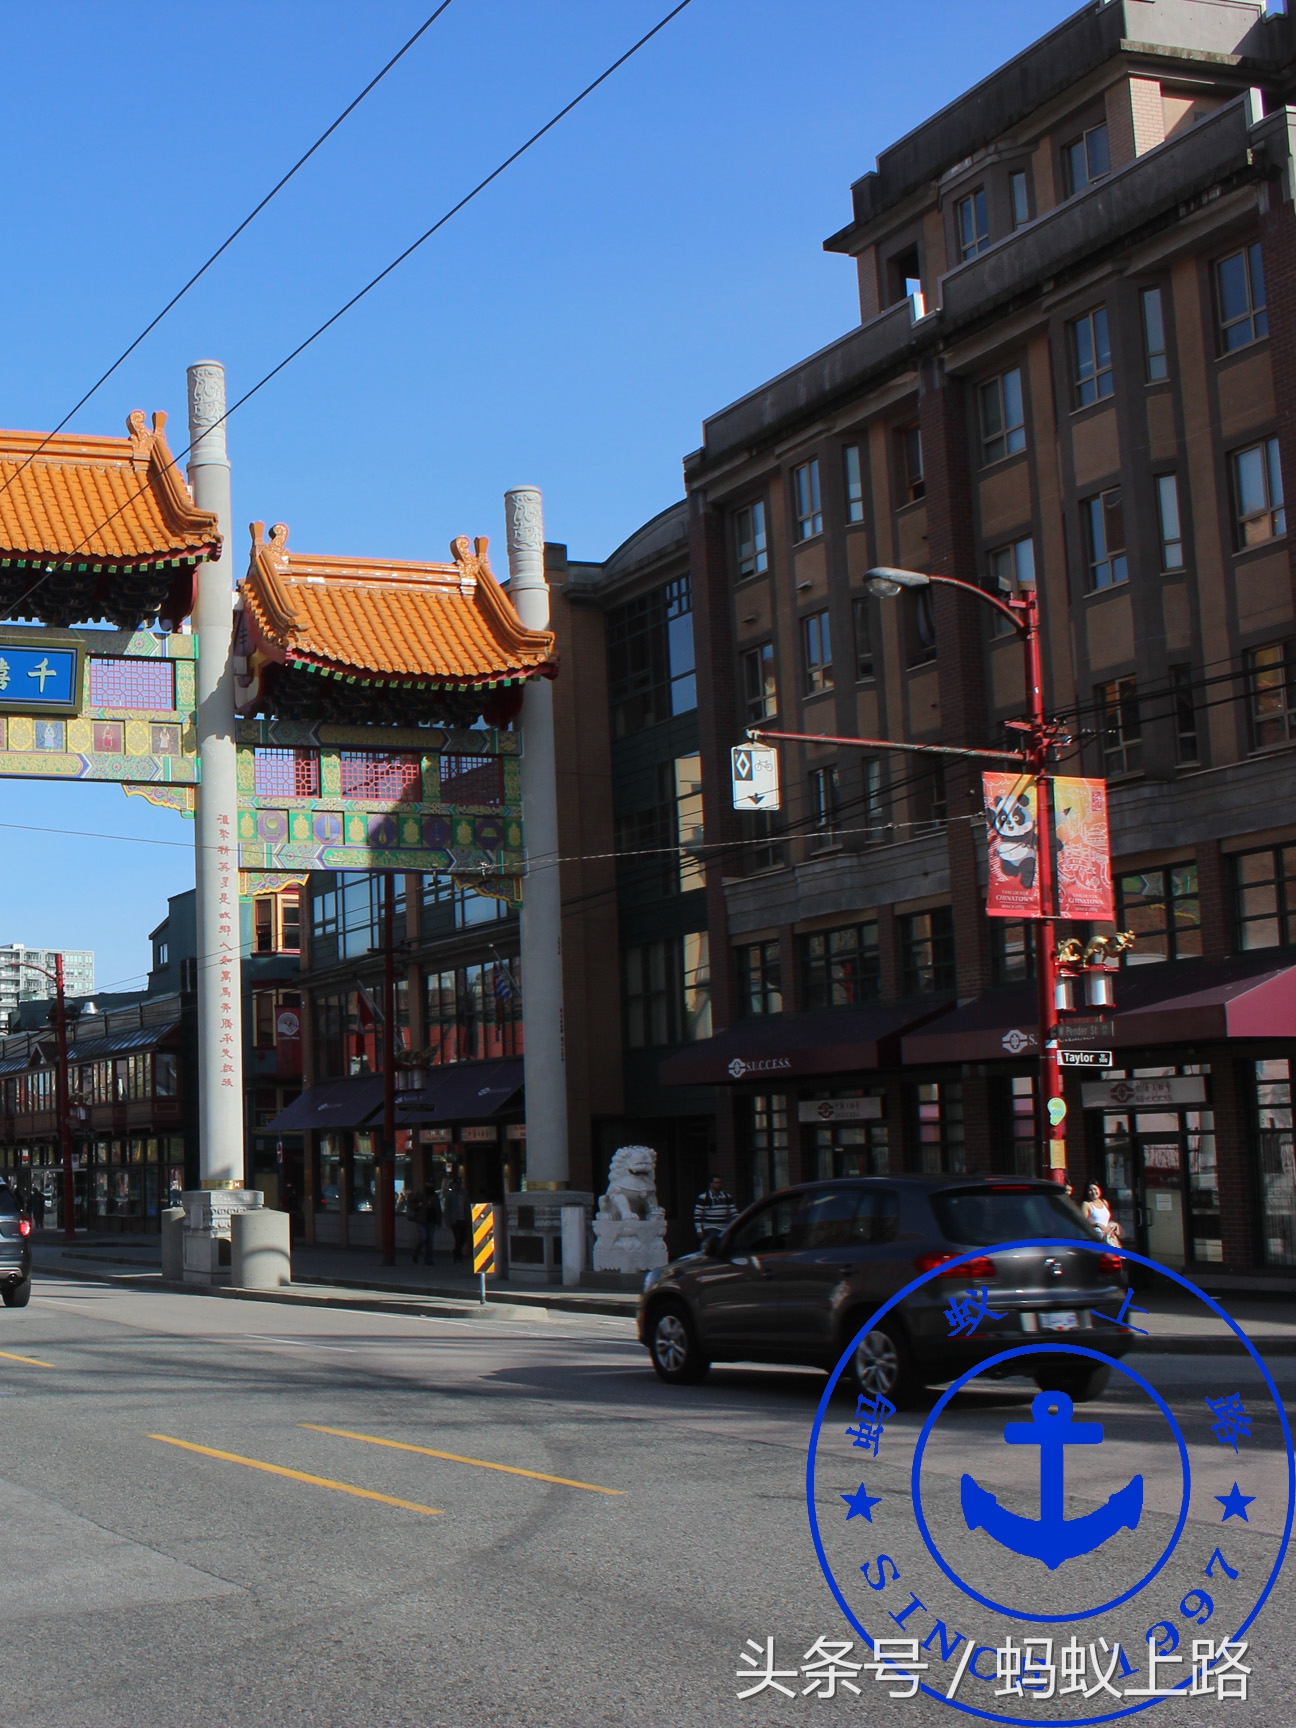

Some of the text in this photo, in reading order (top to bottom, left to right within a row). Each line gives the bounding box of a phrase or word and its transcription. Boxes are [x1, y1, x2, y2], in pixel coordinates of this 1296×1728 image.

[995, 894, 1034, 903] CHINATOWN
[1067, 897, 1104, 905] CHINATOWN
[1065, 1025, 1088, 1037] Pender
[1064, 1052, 1094, 1065] Taylor
